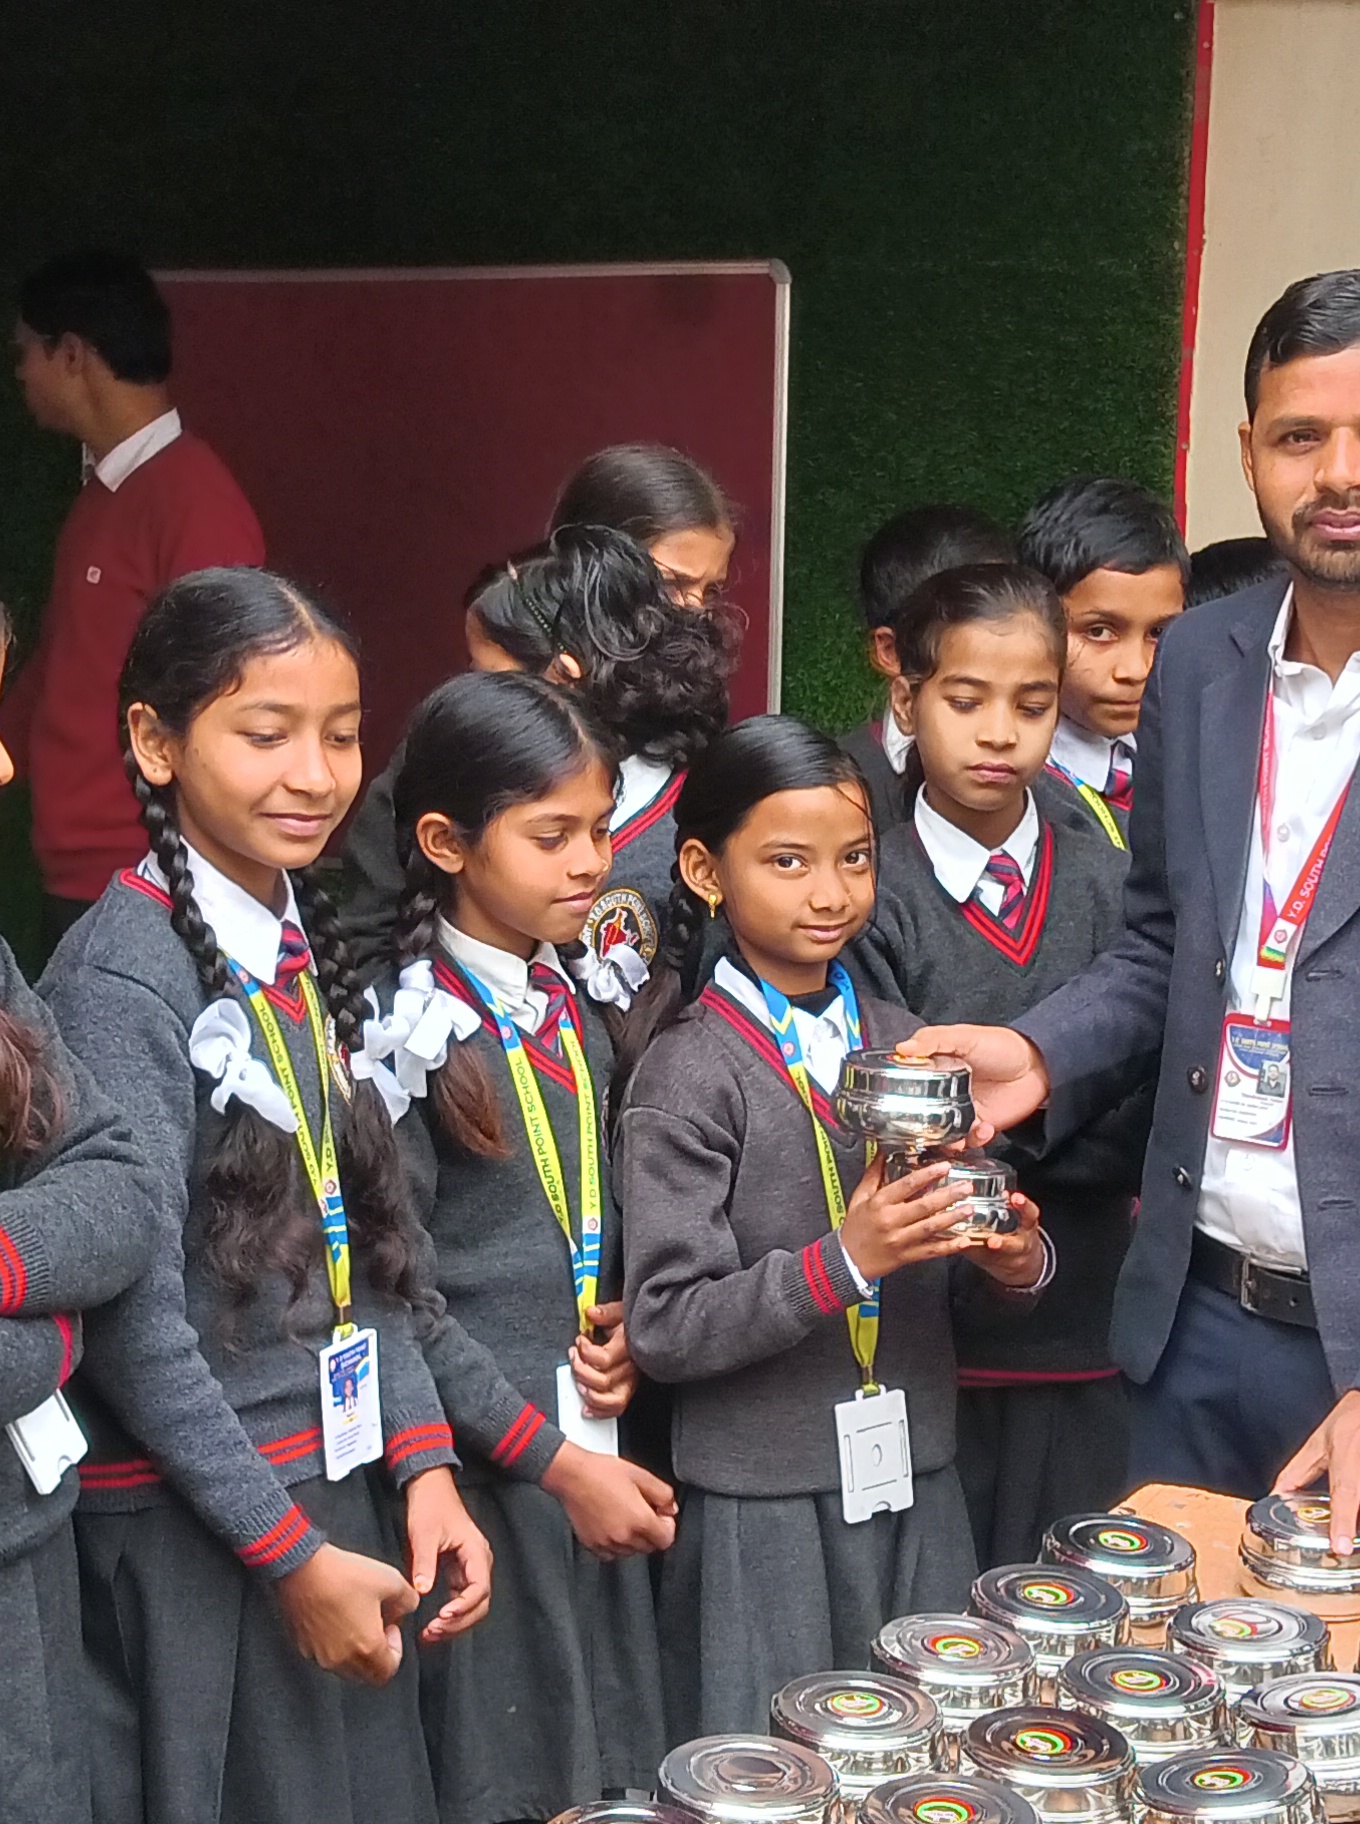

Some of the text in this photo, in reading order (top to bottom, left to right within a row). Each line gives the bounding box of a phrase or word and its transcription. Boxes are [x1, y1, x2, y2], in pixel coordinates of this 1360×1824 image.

[1298, 857, 1323, 899] SOUTH
[259, 1002, 284, 1064] SCHOOL
[280, 1066, 297, 1110] POINT
[515, 1057, 536, 1113] SCHOOL
[529, 1116, 547, 1155] POINT
[585, 1093, 595, 1135] POINT
[326, 1147, 334, 1172] Y.D
[540, 1158, 560, 1202] SOUTH
[587, 1138, 597, 1186] SOUTH
[828, 1166, 844, 1214] SOUTH
